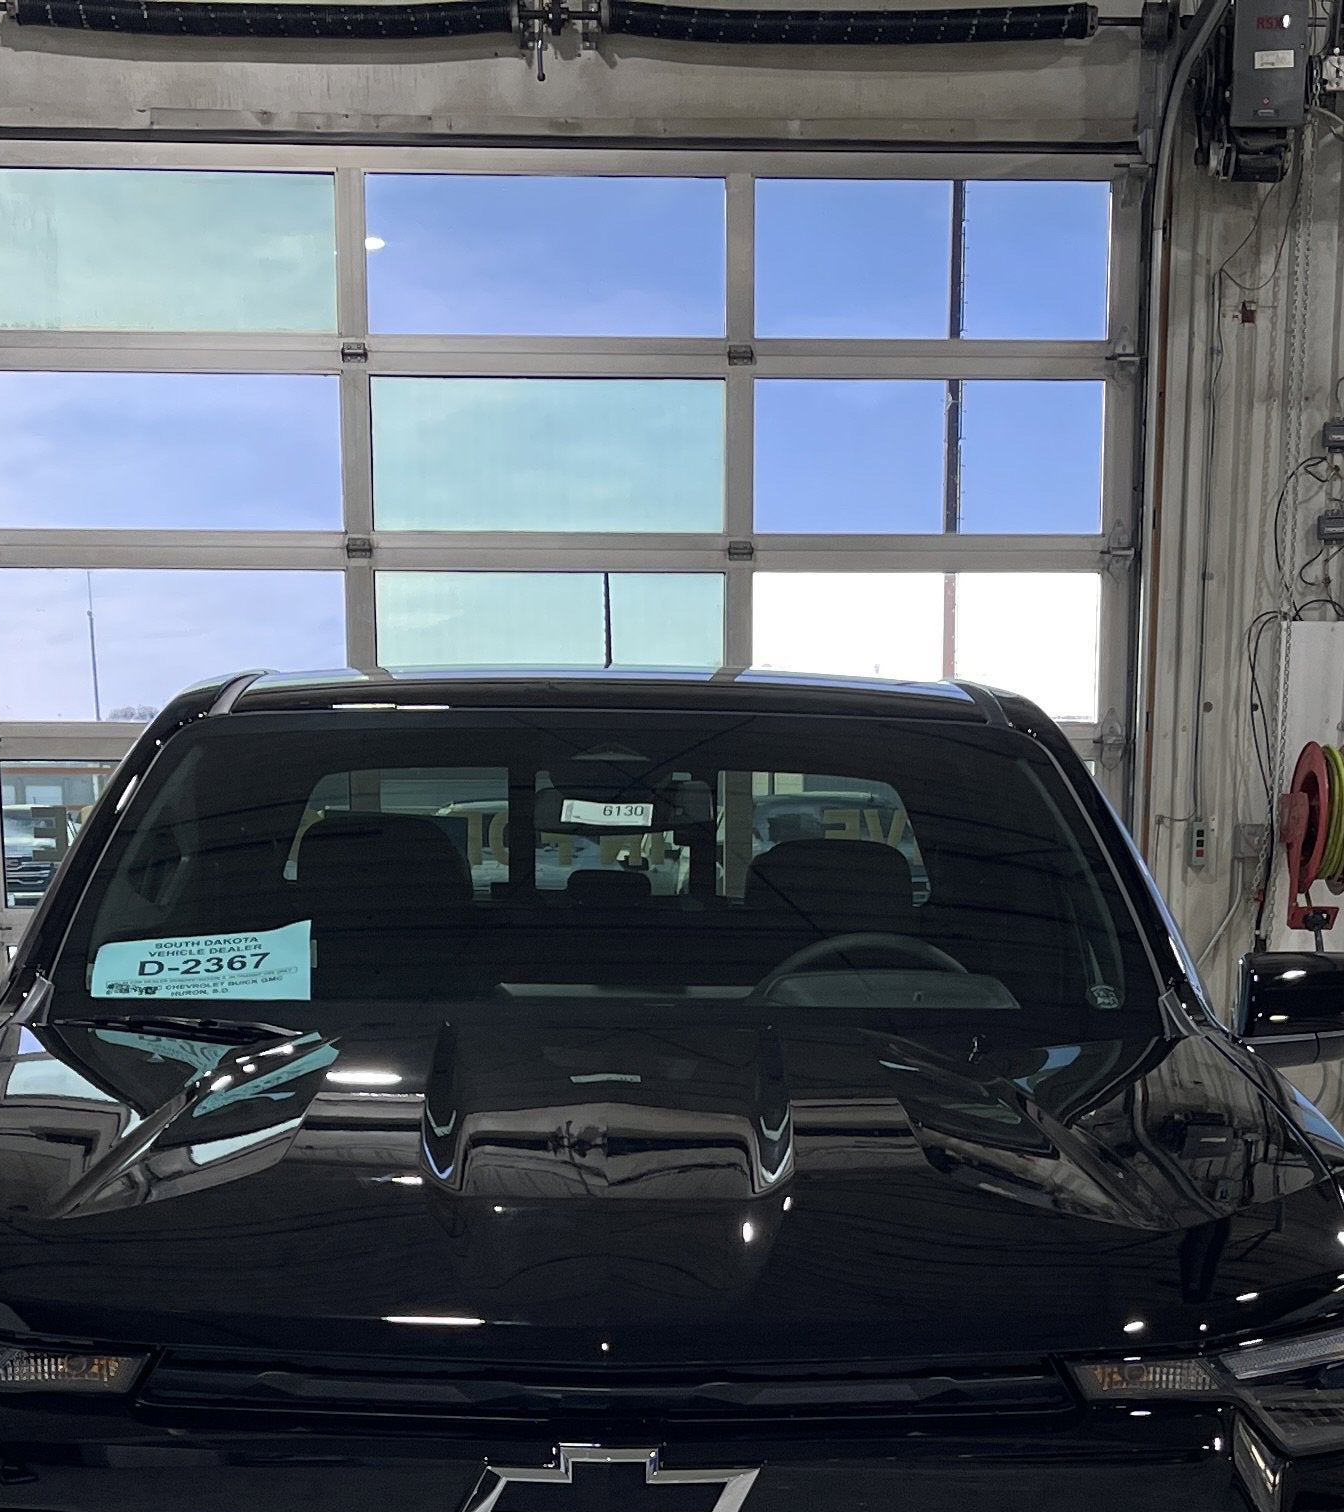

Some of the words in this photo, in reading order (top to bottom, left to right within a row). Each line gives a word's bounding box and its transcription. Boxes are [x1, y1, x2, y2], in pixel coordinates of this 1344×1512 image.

[603, 805, 645, 817] 6130
[155, 940, 200, 949] SOUTH
[204, 936, 259, 947] DAKOTA
[148, 947, 206, 958] VEHICLE
[209, 943, 262, 955] DEALER
[138, 952, 270, 976] D-2367
[165, 981, 225, 991] CHEVROLET
